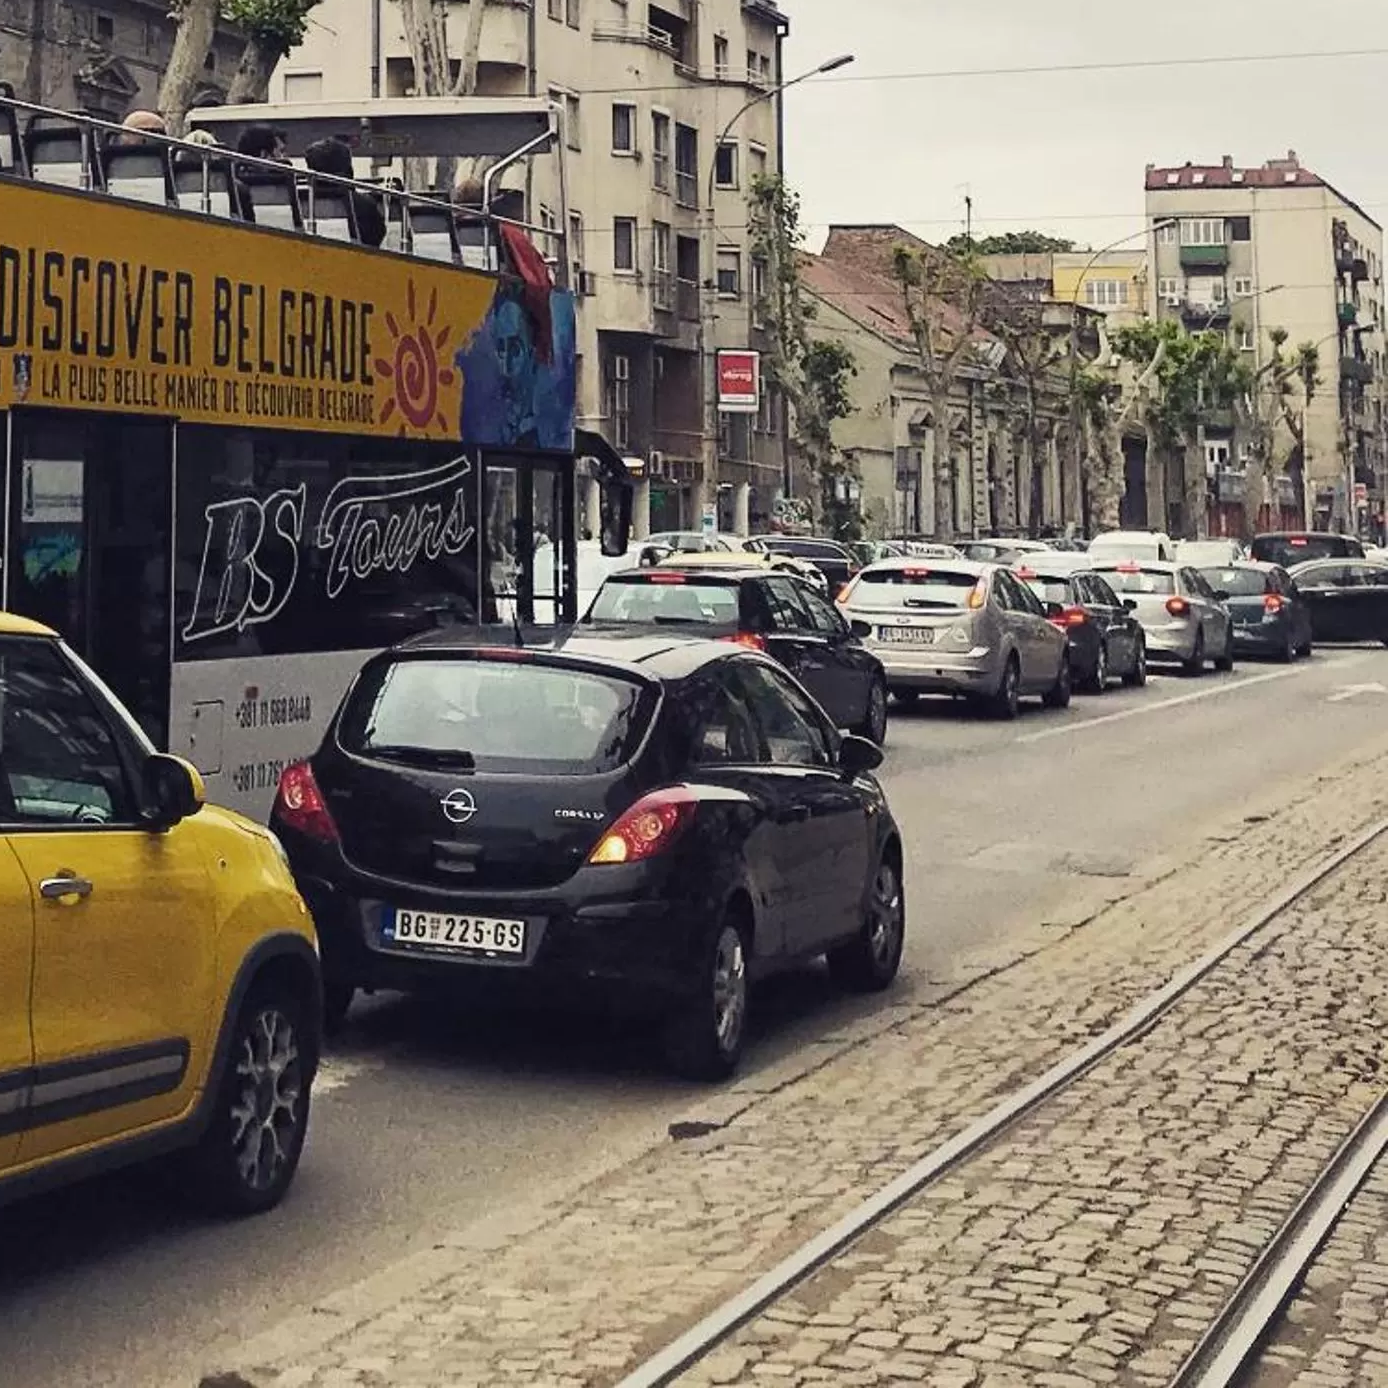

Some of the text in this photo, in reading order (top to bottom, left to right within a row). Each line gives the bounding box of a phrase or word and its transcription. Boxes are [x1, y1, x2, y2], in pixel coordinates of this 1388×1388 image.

[213, 276, 375, 387] BELGRADE
[42, 362, 61, 399] LA
[69, 364, 107, 403] PLUS
[114, 368, 158, 407] BELLE
[224, 379, 239, 413] DE
[318, 387, 375, 425] BELGRADE
[182, 483, 306, 643] BS
[316, 455, 475, 599] Tours
[399, 912, 427, 938] BG
